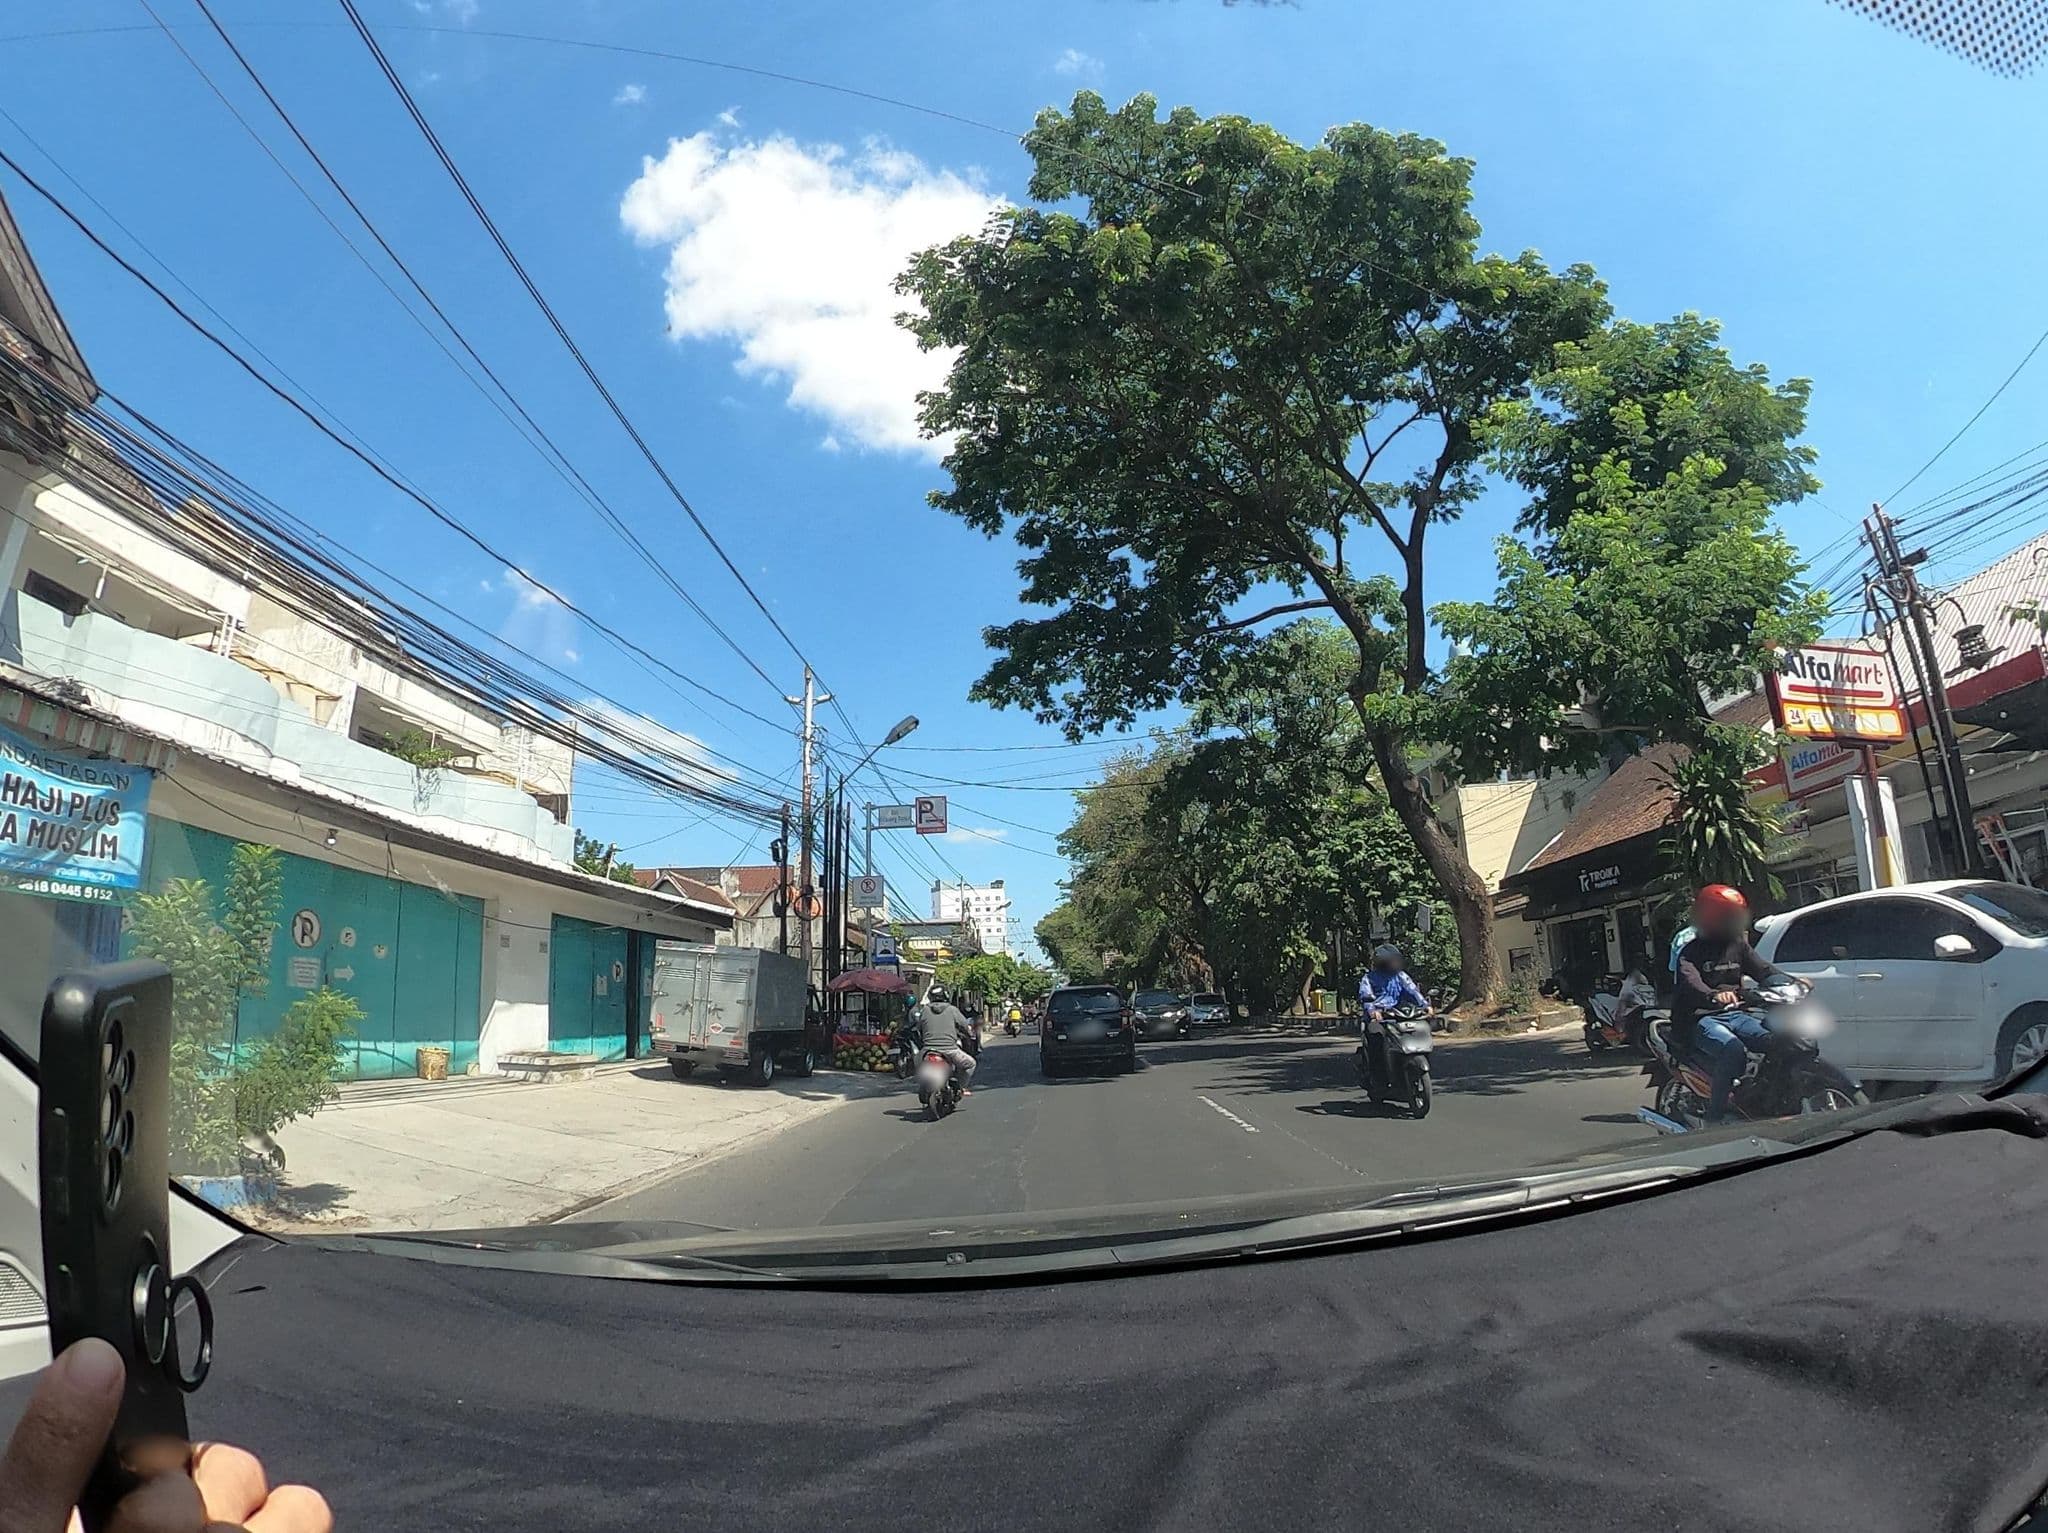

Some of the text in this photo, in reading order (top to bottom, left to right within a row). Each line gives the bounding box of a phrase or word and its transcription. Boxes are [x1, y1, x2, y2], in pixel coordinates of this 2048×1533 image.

[1782, 650, 1883, 685] Alfamart
[2, 772, 120, 826] HAJI PLUS
[0, 811, 118, 861] A MUSLIM
